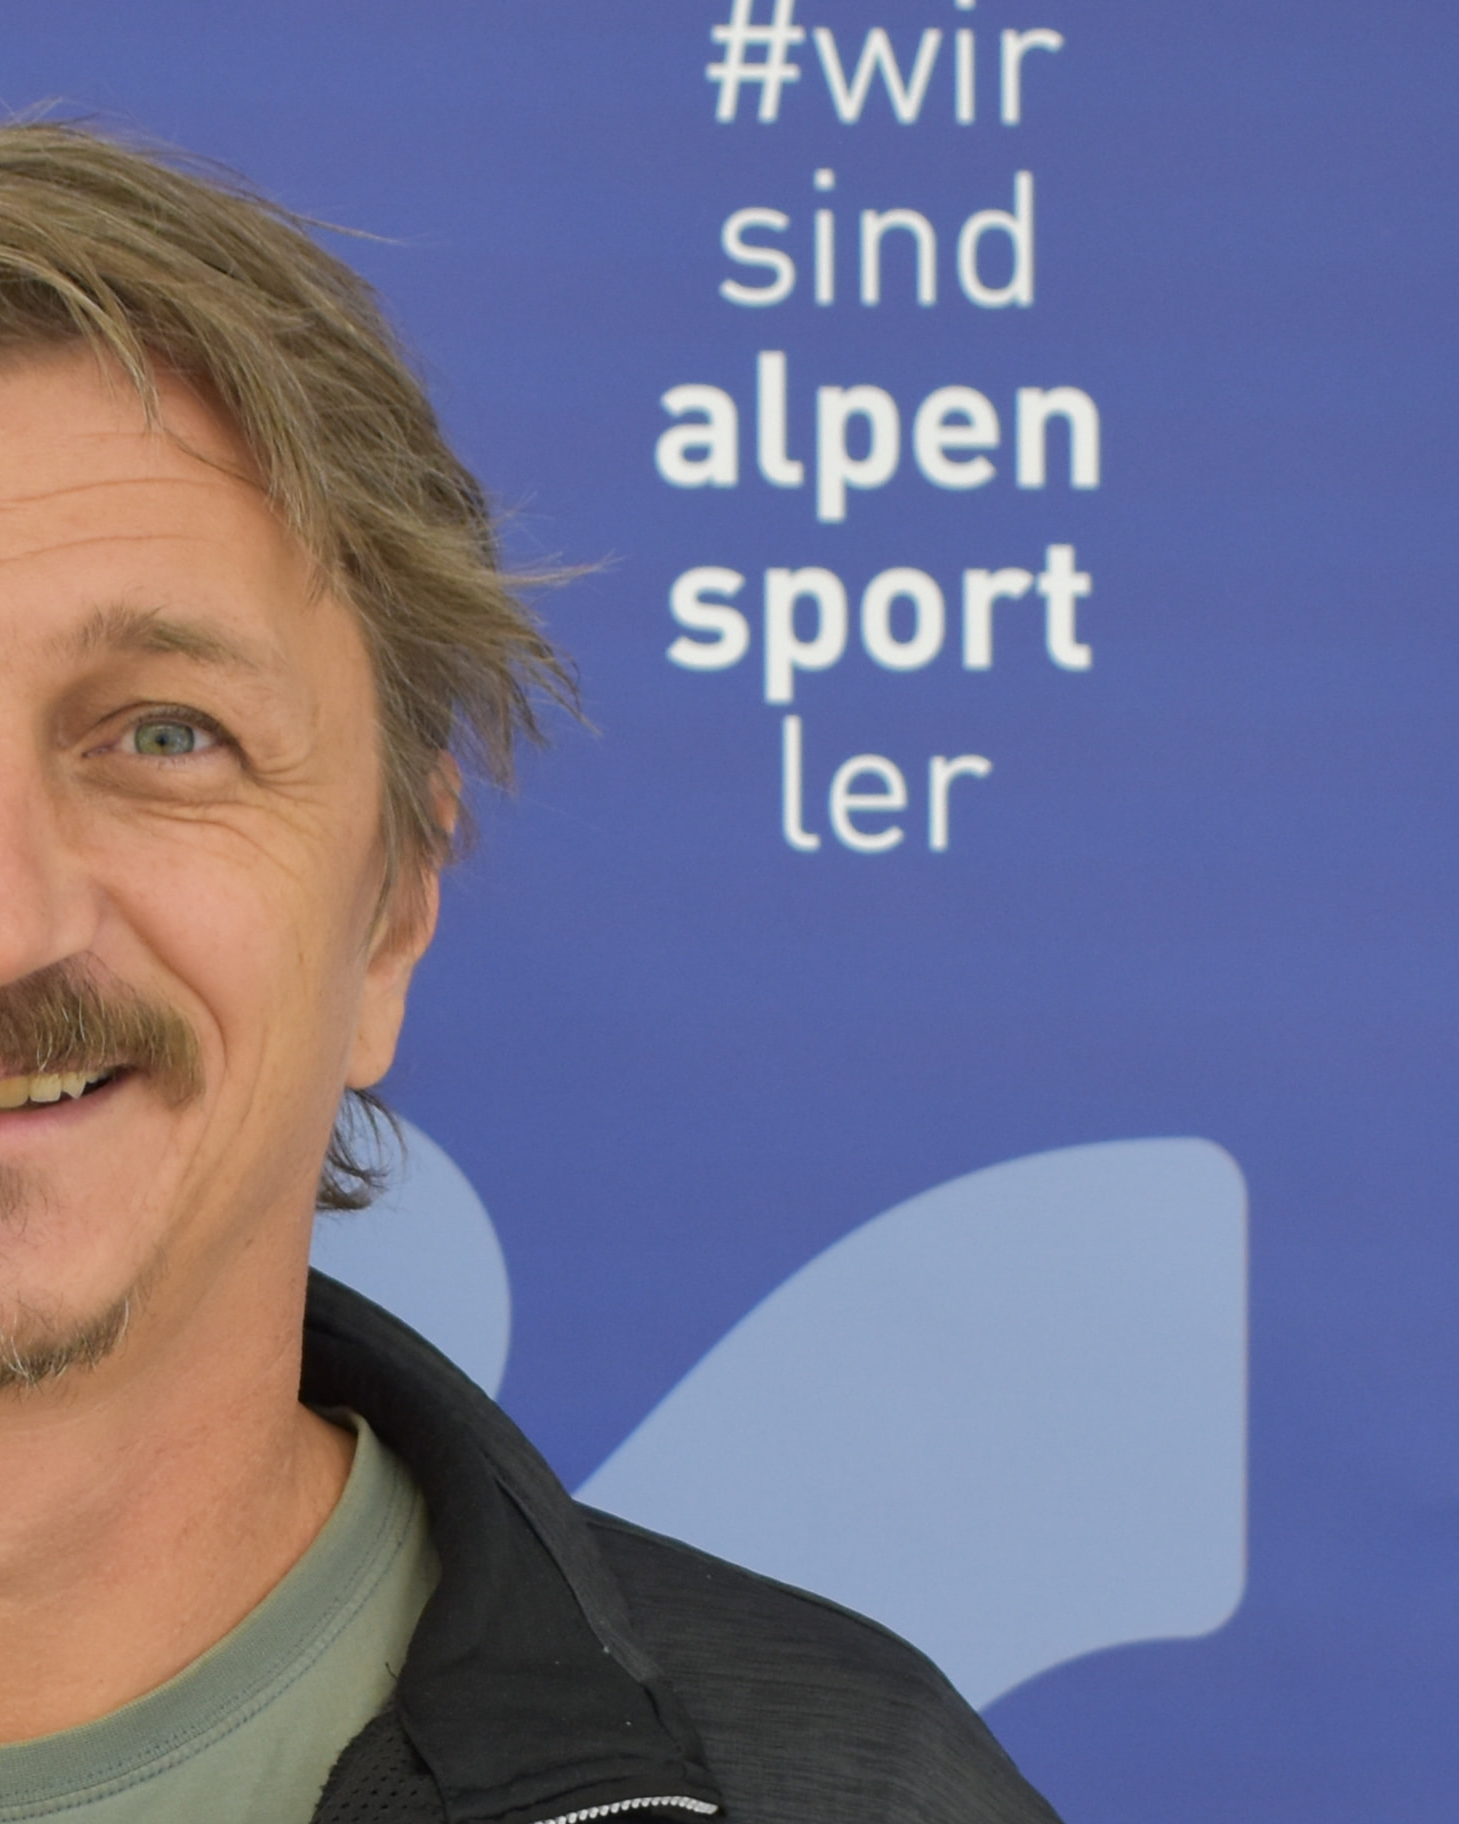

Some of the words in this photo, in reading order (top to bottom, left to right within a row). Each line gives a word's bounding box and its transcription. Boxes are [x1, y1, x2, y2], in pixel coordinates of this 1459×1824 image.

[706, 0, 1065, 125] #wir
[719, 167, 1035, 309] sind
[654, 349, 1101, 523] alpen
[666, 543, 1093, 705] sport
[781, 714, 993, 853] ler
